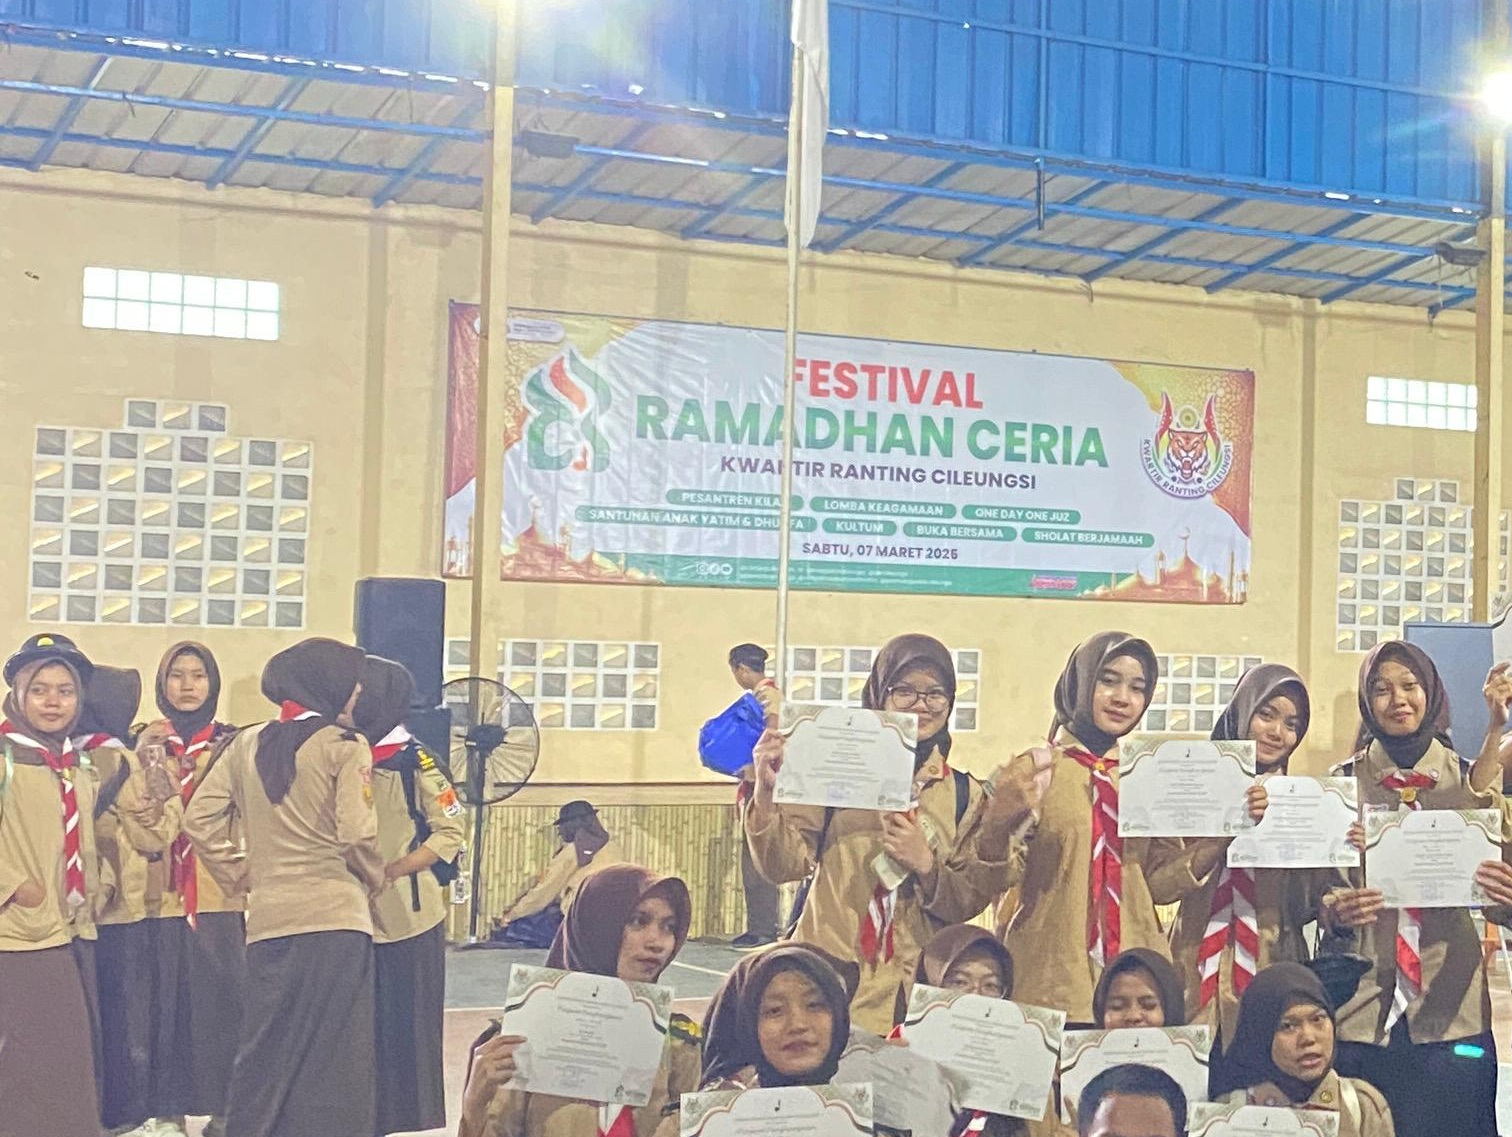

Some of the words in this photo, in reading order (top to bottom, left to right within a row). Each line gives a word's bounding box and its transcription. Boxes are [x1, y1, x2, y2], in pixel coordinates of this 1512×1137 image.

[636, 394, 954, 458] RAMADHAN
[966, 419, 1109, 468] CERIA
[830, 463, 927, 484] RANTING
[931, 469, 1036, 490] CILEUNGSI
[681, 492, 753, 506] PESANTREN
[755, 496, 783, 507] KILA
[824, 499, 866, 512] LOMBA
[867, 501, 944, 516] KEAGAMAAN
[589, 508, 660, 523] SANTUNAN
[662, 511, 699, 524] ANAK
[701, 513, 740, 526] YATIM
[742, 515, 752, 527] &
[755, 516, 804, 529] DHUFA
[975, 507, 999, 519] ONE
[1000, 508, 1024, 520] DAY
[1025, 510, 1048, 522] ONE
[1050, 511, 1071, 523] JUZ
[835, 520, 884, 533] KULTUM
[916, 524, 949, 537] BUKA
[950, 526, 1004, 539] BERSAMA
[1034, 530, 1076, 543] SHOLAT
[1077, 532, 1144, 546] BERJAMAAH
[802, 542, 854, 558] SABTU,
[856, 544, 873, 557] 07
[875, 545, 924, 560] MARET
